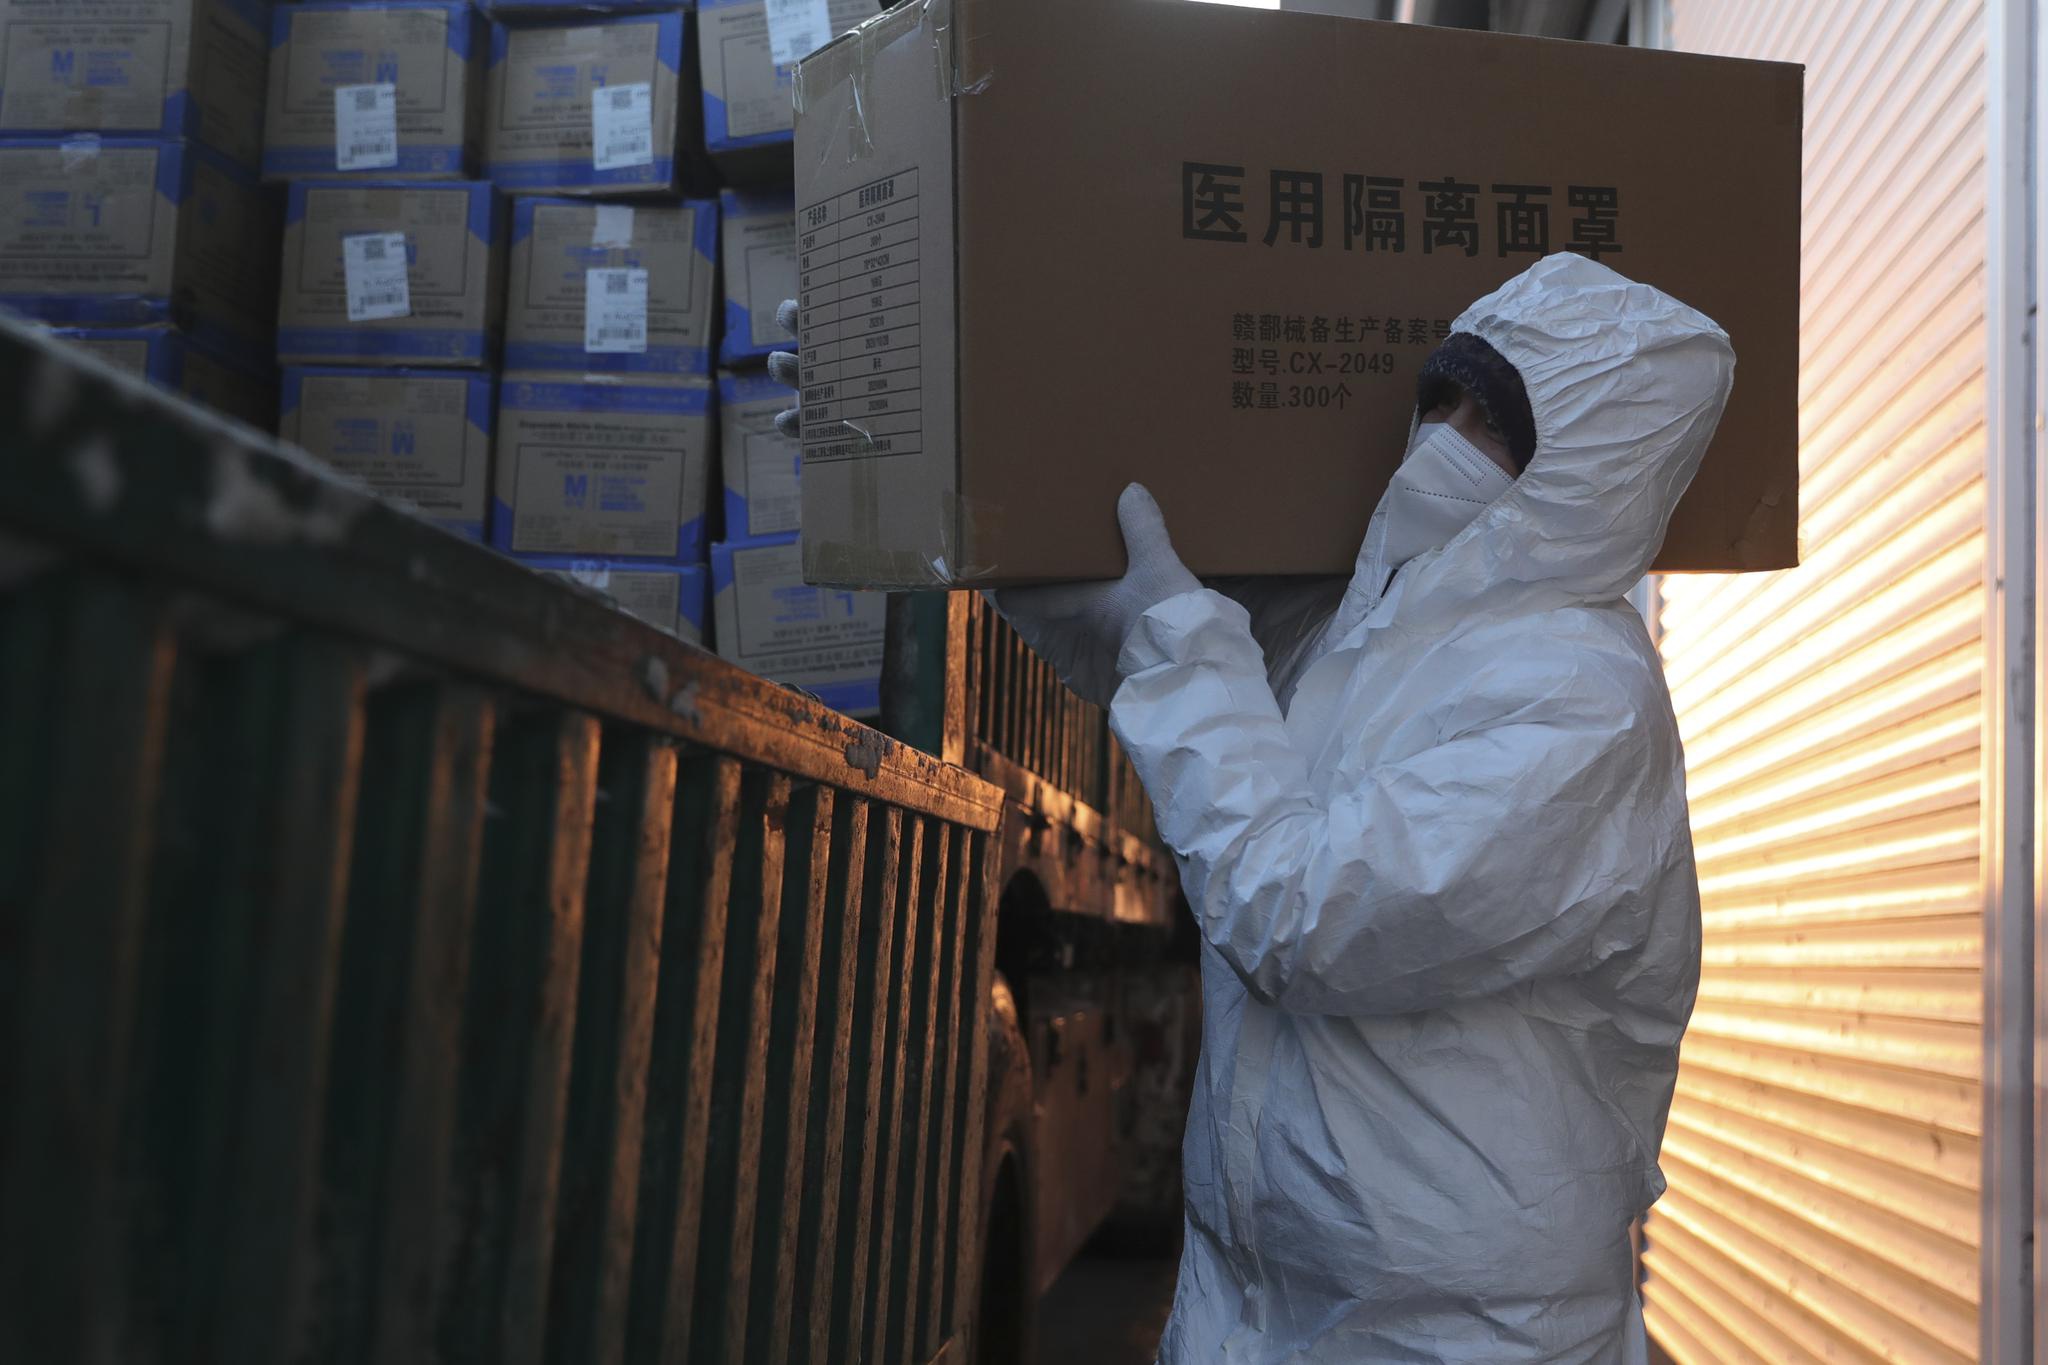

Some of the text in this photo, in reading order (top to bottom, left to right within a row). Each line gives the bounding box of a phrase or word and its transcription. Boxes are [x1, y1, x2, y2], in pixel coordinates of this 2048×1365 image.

[1182, 161, 1623, 262] 医用隔离面罩
[1231, 313, 1451, 344] 赣鄱械备生产备案号
